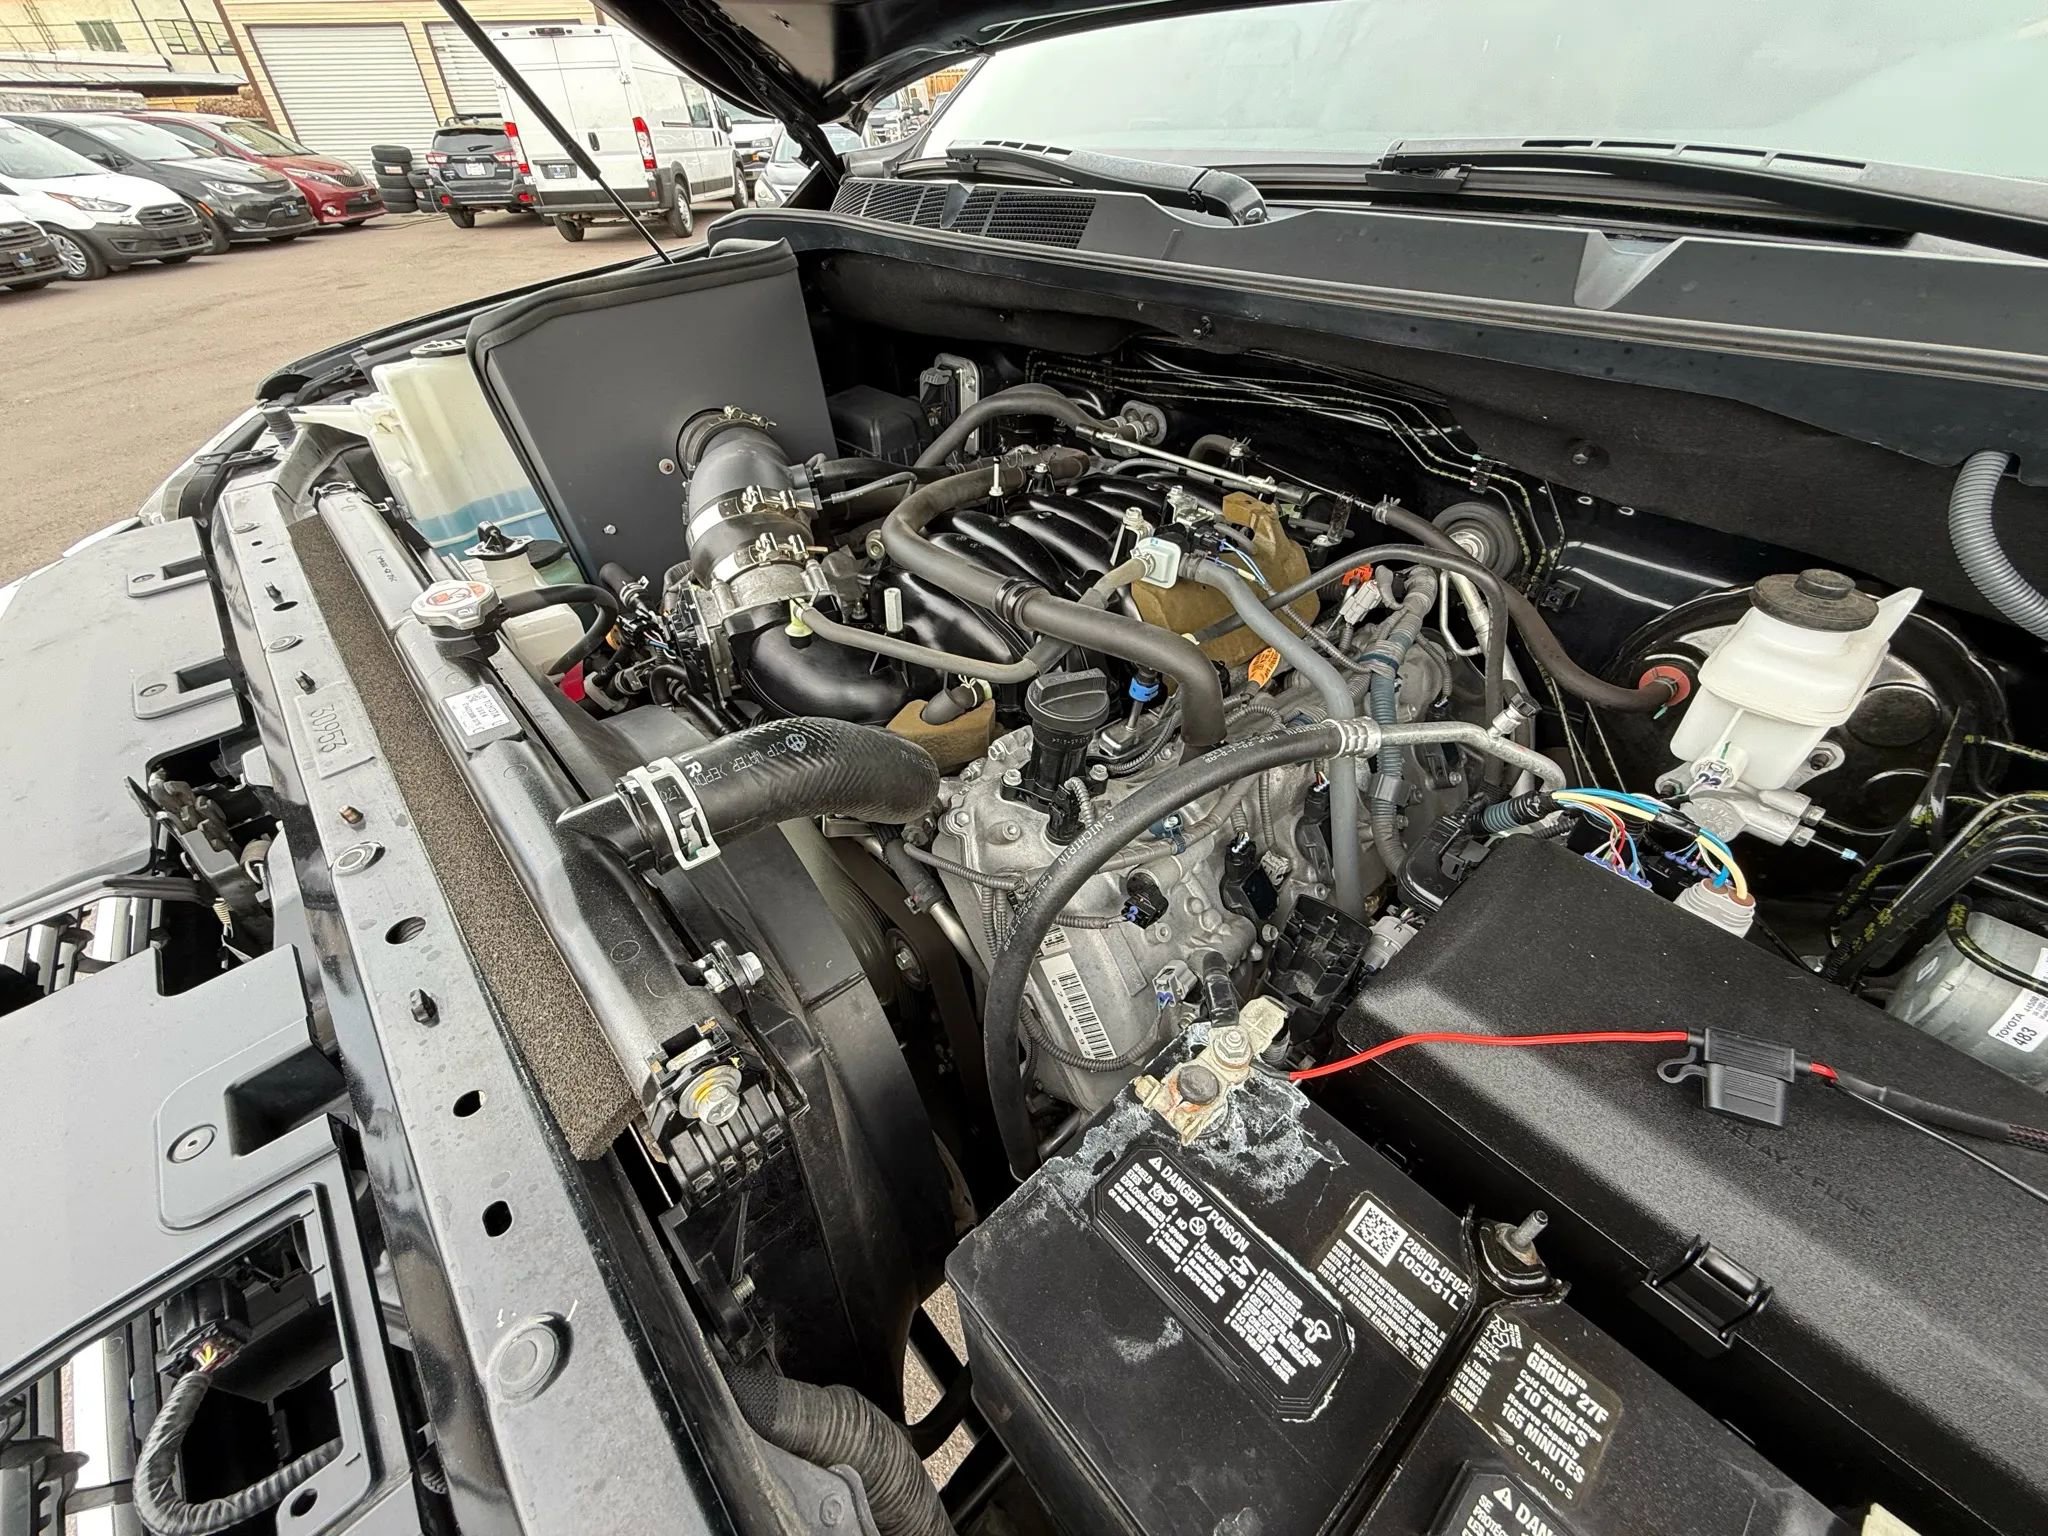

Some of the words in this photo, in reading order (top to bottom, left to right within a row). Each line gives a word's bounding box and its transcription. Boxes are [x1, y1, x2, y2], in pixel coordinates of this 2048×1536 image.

[311, 705, 348, 753] 30953
[1055, 820, 1104, 865] NICHIRIN
[1996, 1013, 2024, 1039] TOYOTA
[2012, 1026, 2038, 1047] 483
[1120, 1176, 1149, 1205] EXPLOSIVE
[1146, 1202, 1166, 1222] GASES
[1126, 1169, 1142, 1185] EYES
[1176, 1217, 1187, 1230] NO
[1201, 1243, 1231, 1274] SULFURIC
[1228, 1272, 1246, 1289] ACID
[1352, 1254, 1361, 1262] BY
[1360, 1260, 1379, 1280] TOYOTA
[1378, 1276, 1397, 1296] MOTOR
[1396, 1293, 1415, 1312] NORTH
[1398, 1250, 1458, 1310] 105D31L
[1342, 1266, 1350, 1274] BY
[1349, 1272, 1368, 1291] TOYOTA
[1366, 1288, 1375, 1298] DE
[1420, 1336, 1432, 1350] SAN
[1351, 1263, 1362, 1274] BY
[1360, 1272, 1385, 1296] SERVCO
[1384, 1293, 1409, 1317] PACIFIC
[1338, 1284, 1349, 1295] BY
[1348, 1294, 1371, 1317] ATKINS
[1412, 1351, 1428, 1369] TAM
[1468, 1380, 1482, 1396] RICO
[1472, 1360, 1491, 1380] TEXAS
[1527, 1352, 1577, 1396] GROUP
[1576, 1393, 1608, 1423] 27F
[1534, 1342, 1566, 1372] Replace
[1568, 1369, 1587, 1389] With
[1451, 1389, 1474, 1412] GUAM
[1515, 1378, 1541, 1407] 710
[1541, 1404, 1588, 1447] AMPS
[1520, 1369, 1539, 1388] Cold
[1539, 1386, 1576, 1421] Cranking
[1576, 1417, 1602, 1442] Amps
[1502, 1403, 1525, 1429] 165
[1524, 1423, 1585, 1483] MINUTES
[1507, 1393, 1541, 1426] Reserve
[1542, 1423, 1580, 1460] Capacity
[1516, 1444, 1573, 1499] CLARIOS
[1479, 1495, 1494, 1513] SE
